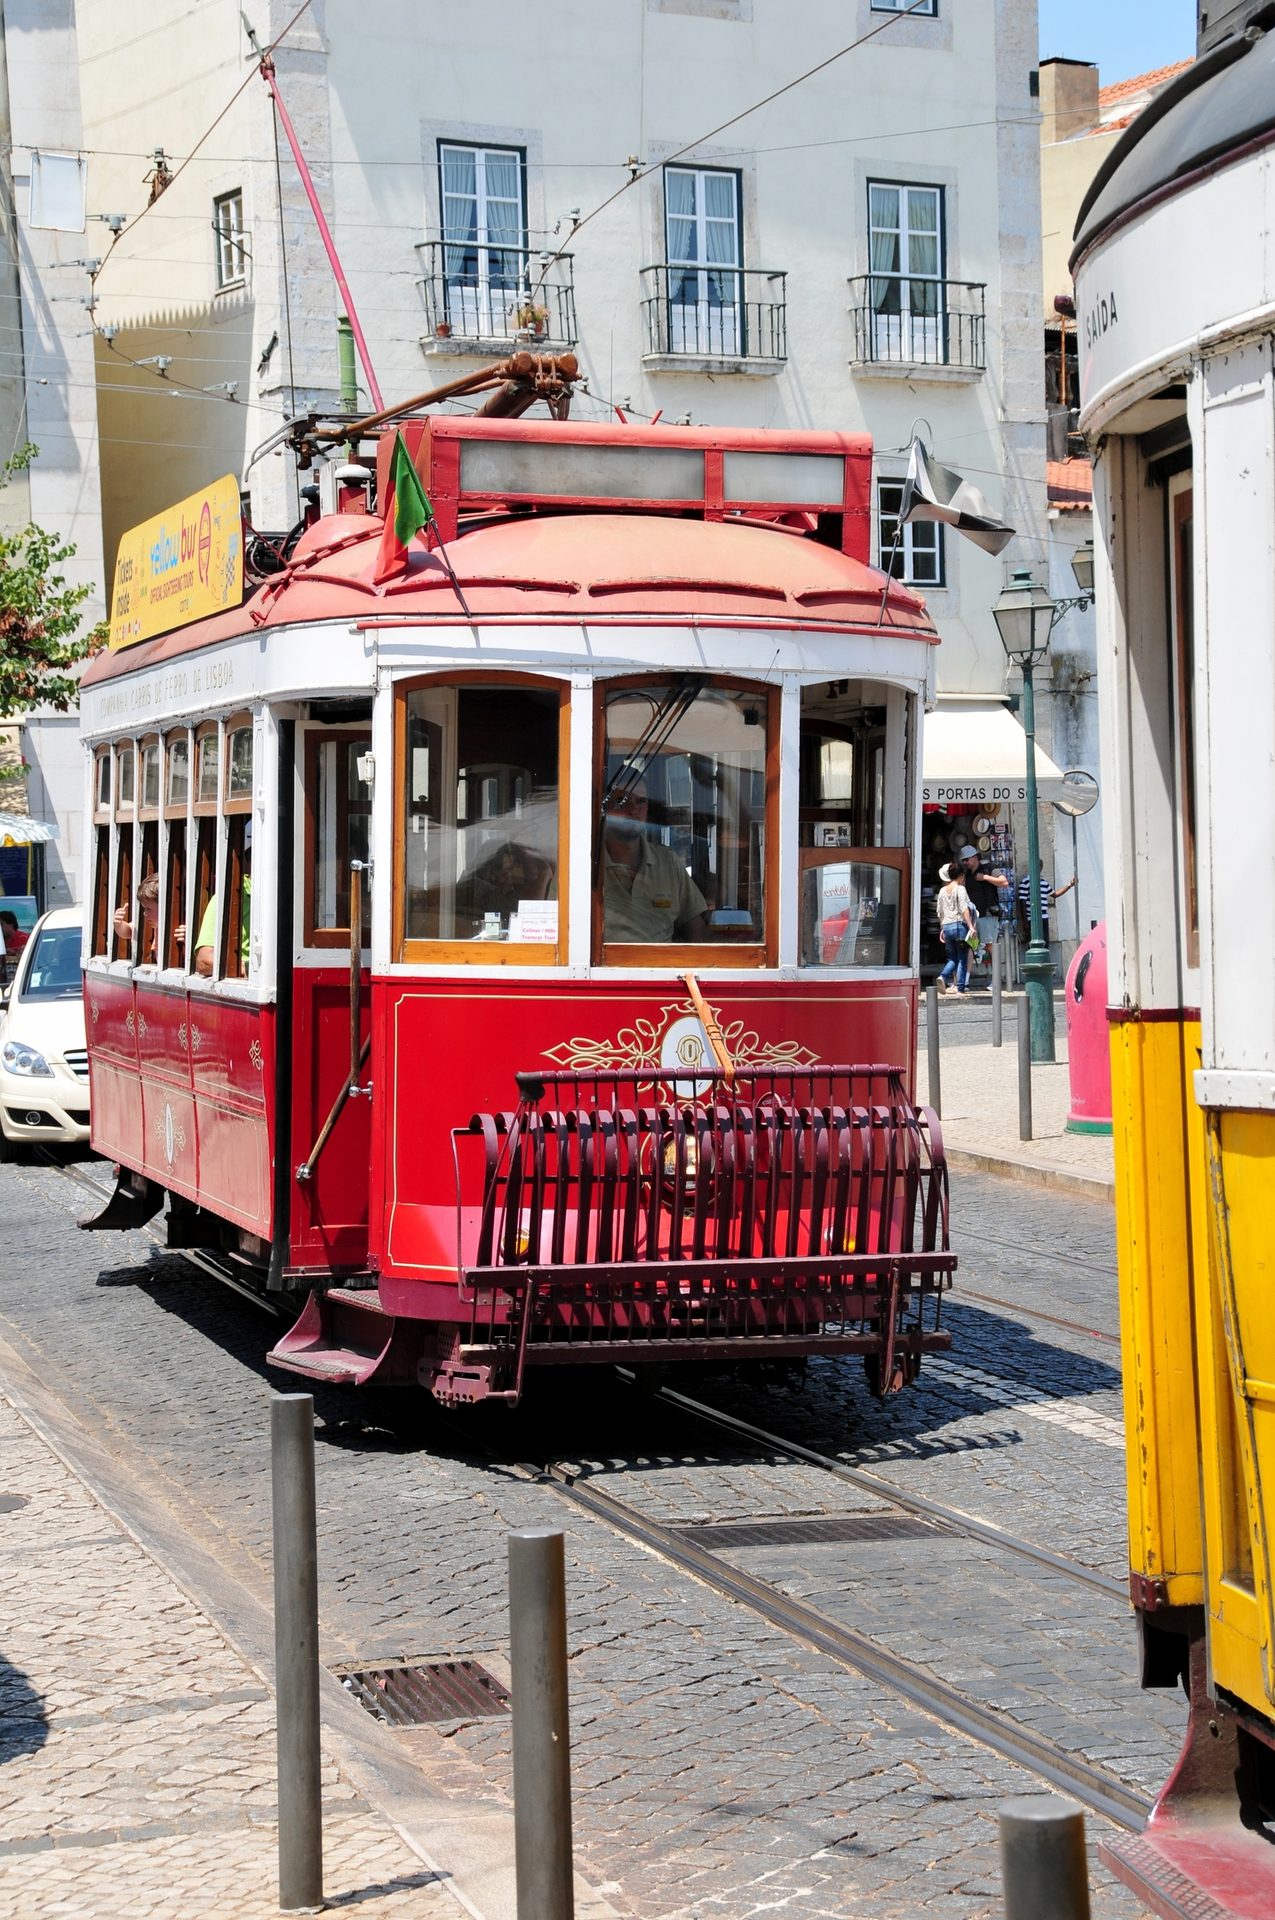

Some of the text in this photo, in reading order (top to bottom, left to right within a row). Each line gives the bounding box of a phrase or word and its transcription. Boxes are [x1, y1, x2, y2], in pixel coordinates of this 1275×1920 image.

[1086, 291, 1118, 349] SAÍDA
[117, 555, 133, 586] Tickets
[150, 514, 196, 577] yellow bus
[131, 683, 151, 711] CARRIS
[155, 680, 162, 705] DE
[164, 672, 188, 701] FERRO
[193, 668, 202, 694] DE
[206, 659, 234, 690] LISBOA
[938, 788, 986, 800] PORTAS
[993, 788, 1011, 800] DO
[1017, 788, 1041, 800] SL
